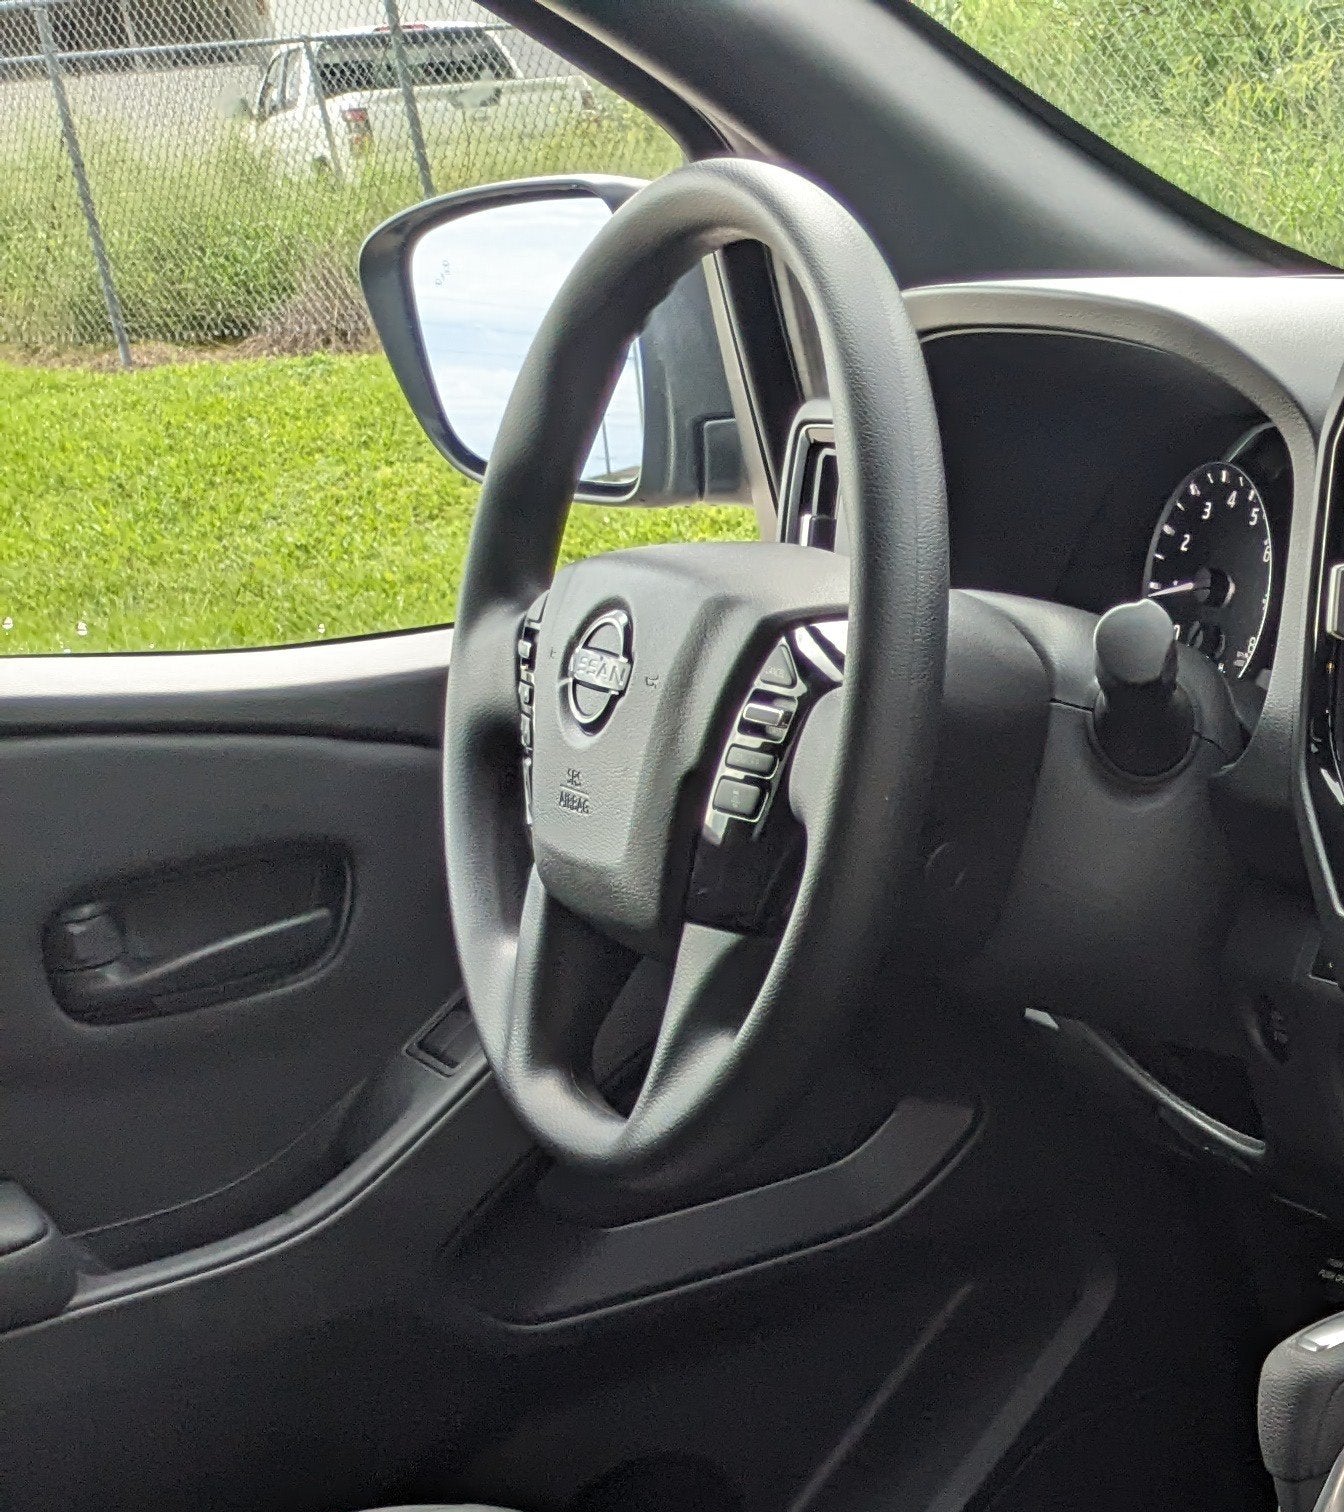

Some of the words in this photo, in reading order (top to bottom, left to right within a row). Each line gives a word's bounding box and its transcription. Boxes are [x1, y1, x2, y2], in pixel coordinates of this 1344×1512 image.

[1226, 490, 1237, 508] 4
[1202, 502, 1212, 520] 3
[1249, 507, 1260, 526] 5
[1180, 533, 1190, 552] 2
